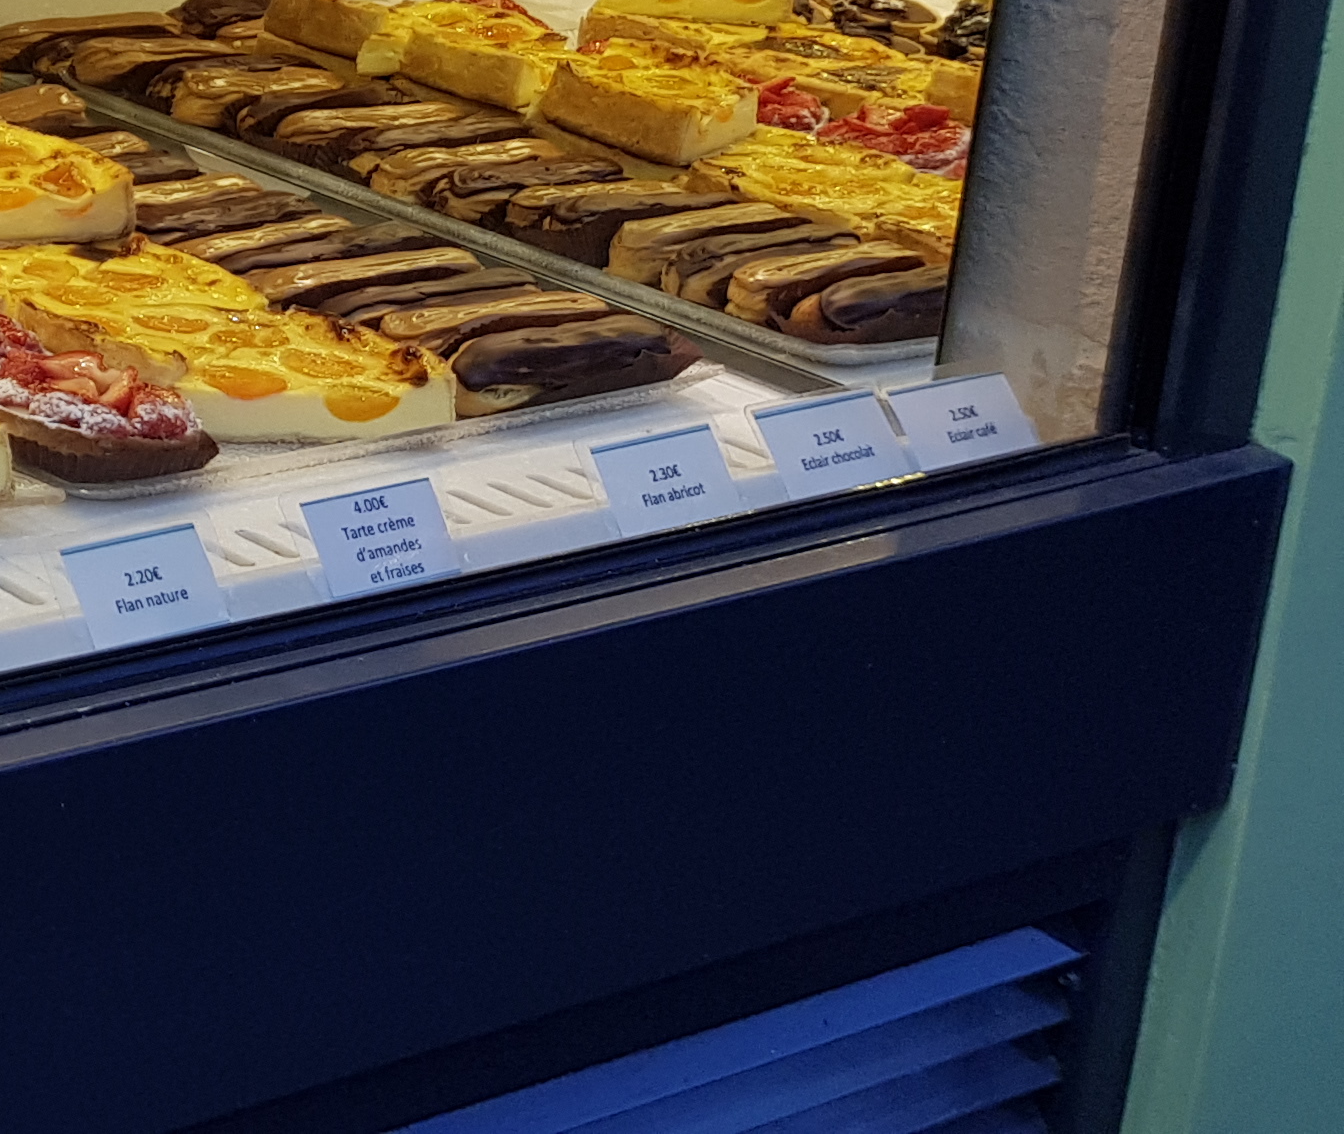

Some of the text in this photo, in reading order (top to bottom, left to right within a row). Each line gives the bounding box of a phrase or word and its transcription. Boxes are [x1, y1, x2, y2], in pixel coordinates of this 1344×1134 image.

[948, 405, 979, 422] 2.50€
[813, 428, 845, 446] 2.50€
[947, 422, 998, 444] Eclair café
[801, 445, 875, 471] Eclair chocolat
[649, 464, 682, 482] 2.30€
[353, 495, 389, 514] 4.00€
[642, 483, 706, 507] Flan abricot
[341, 515, 416, 541] Tarte crème
[124, 566, 163, 587] 2.20€
[370, 562, 425, 584] et fraises
[115, 588, 189, 614] Flan nature
